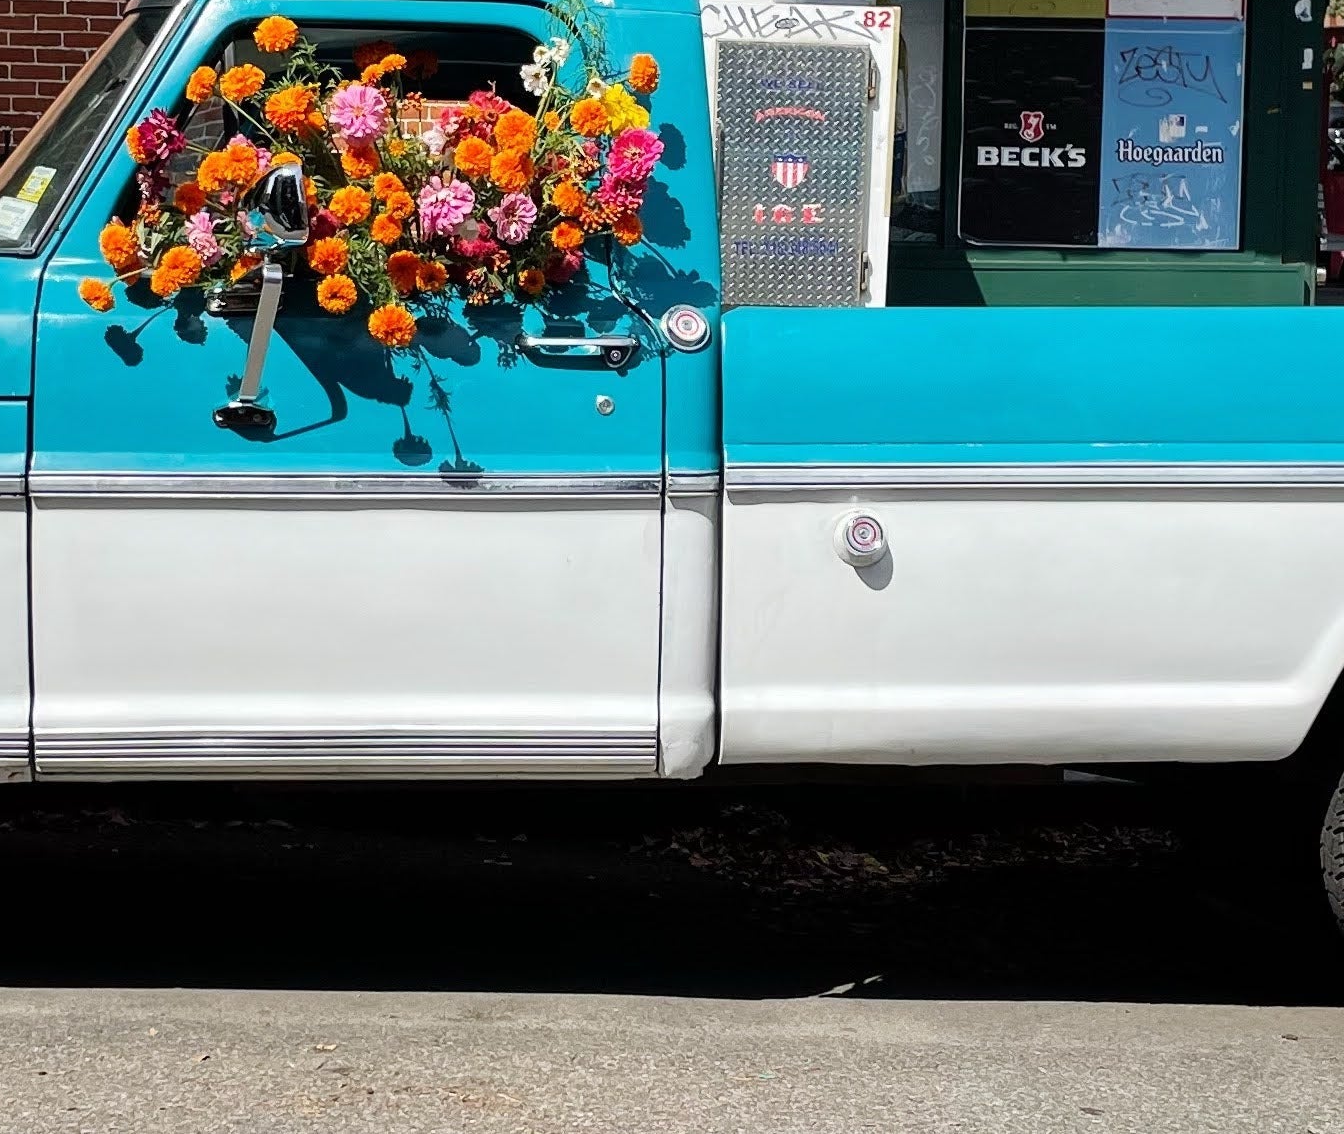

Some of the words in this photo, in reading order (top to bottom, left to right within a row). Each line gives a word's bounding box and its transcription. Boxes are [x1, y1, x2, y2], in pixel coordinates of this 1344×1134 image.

[862, 10, 892, 29] 82
[976, 143, 1087, 168] BECK'S
[1117, 139, 1225, 166] Hoegaarden
[752, 202, 826, 224] ICE
